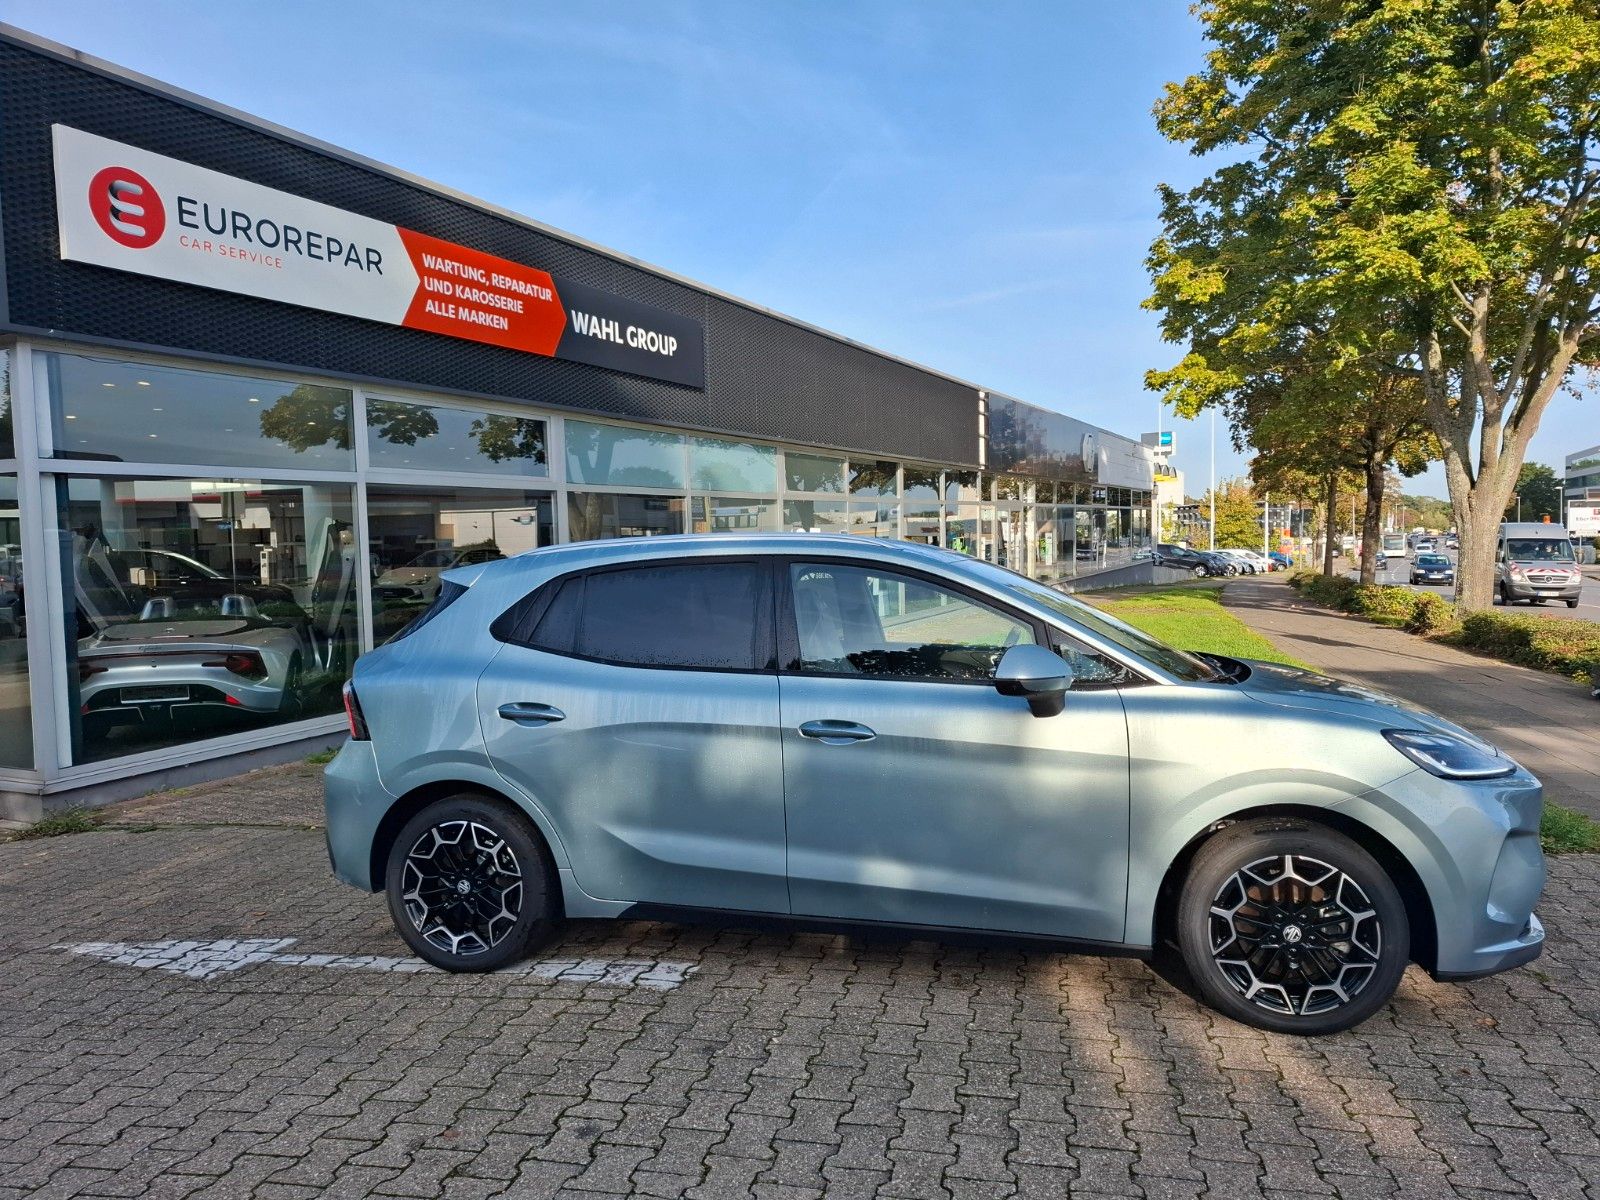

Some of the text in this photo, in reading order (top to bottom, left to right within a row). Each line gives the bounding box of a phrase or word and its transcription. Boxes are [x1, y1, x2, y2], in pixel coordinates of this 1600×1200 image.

[177, 195, 383, 275] EUROREPAR
[179, 235, 282, 268] CAR SERVICE
[422, 252, 552, 302] WARTUNG, REPARATUR
[424, 275, 523, 313] UND KAROSSERIE
[425, 299, 508, 330] ALLE MARKEN
[571, 309, 677, 356] WAHL GROUP
